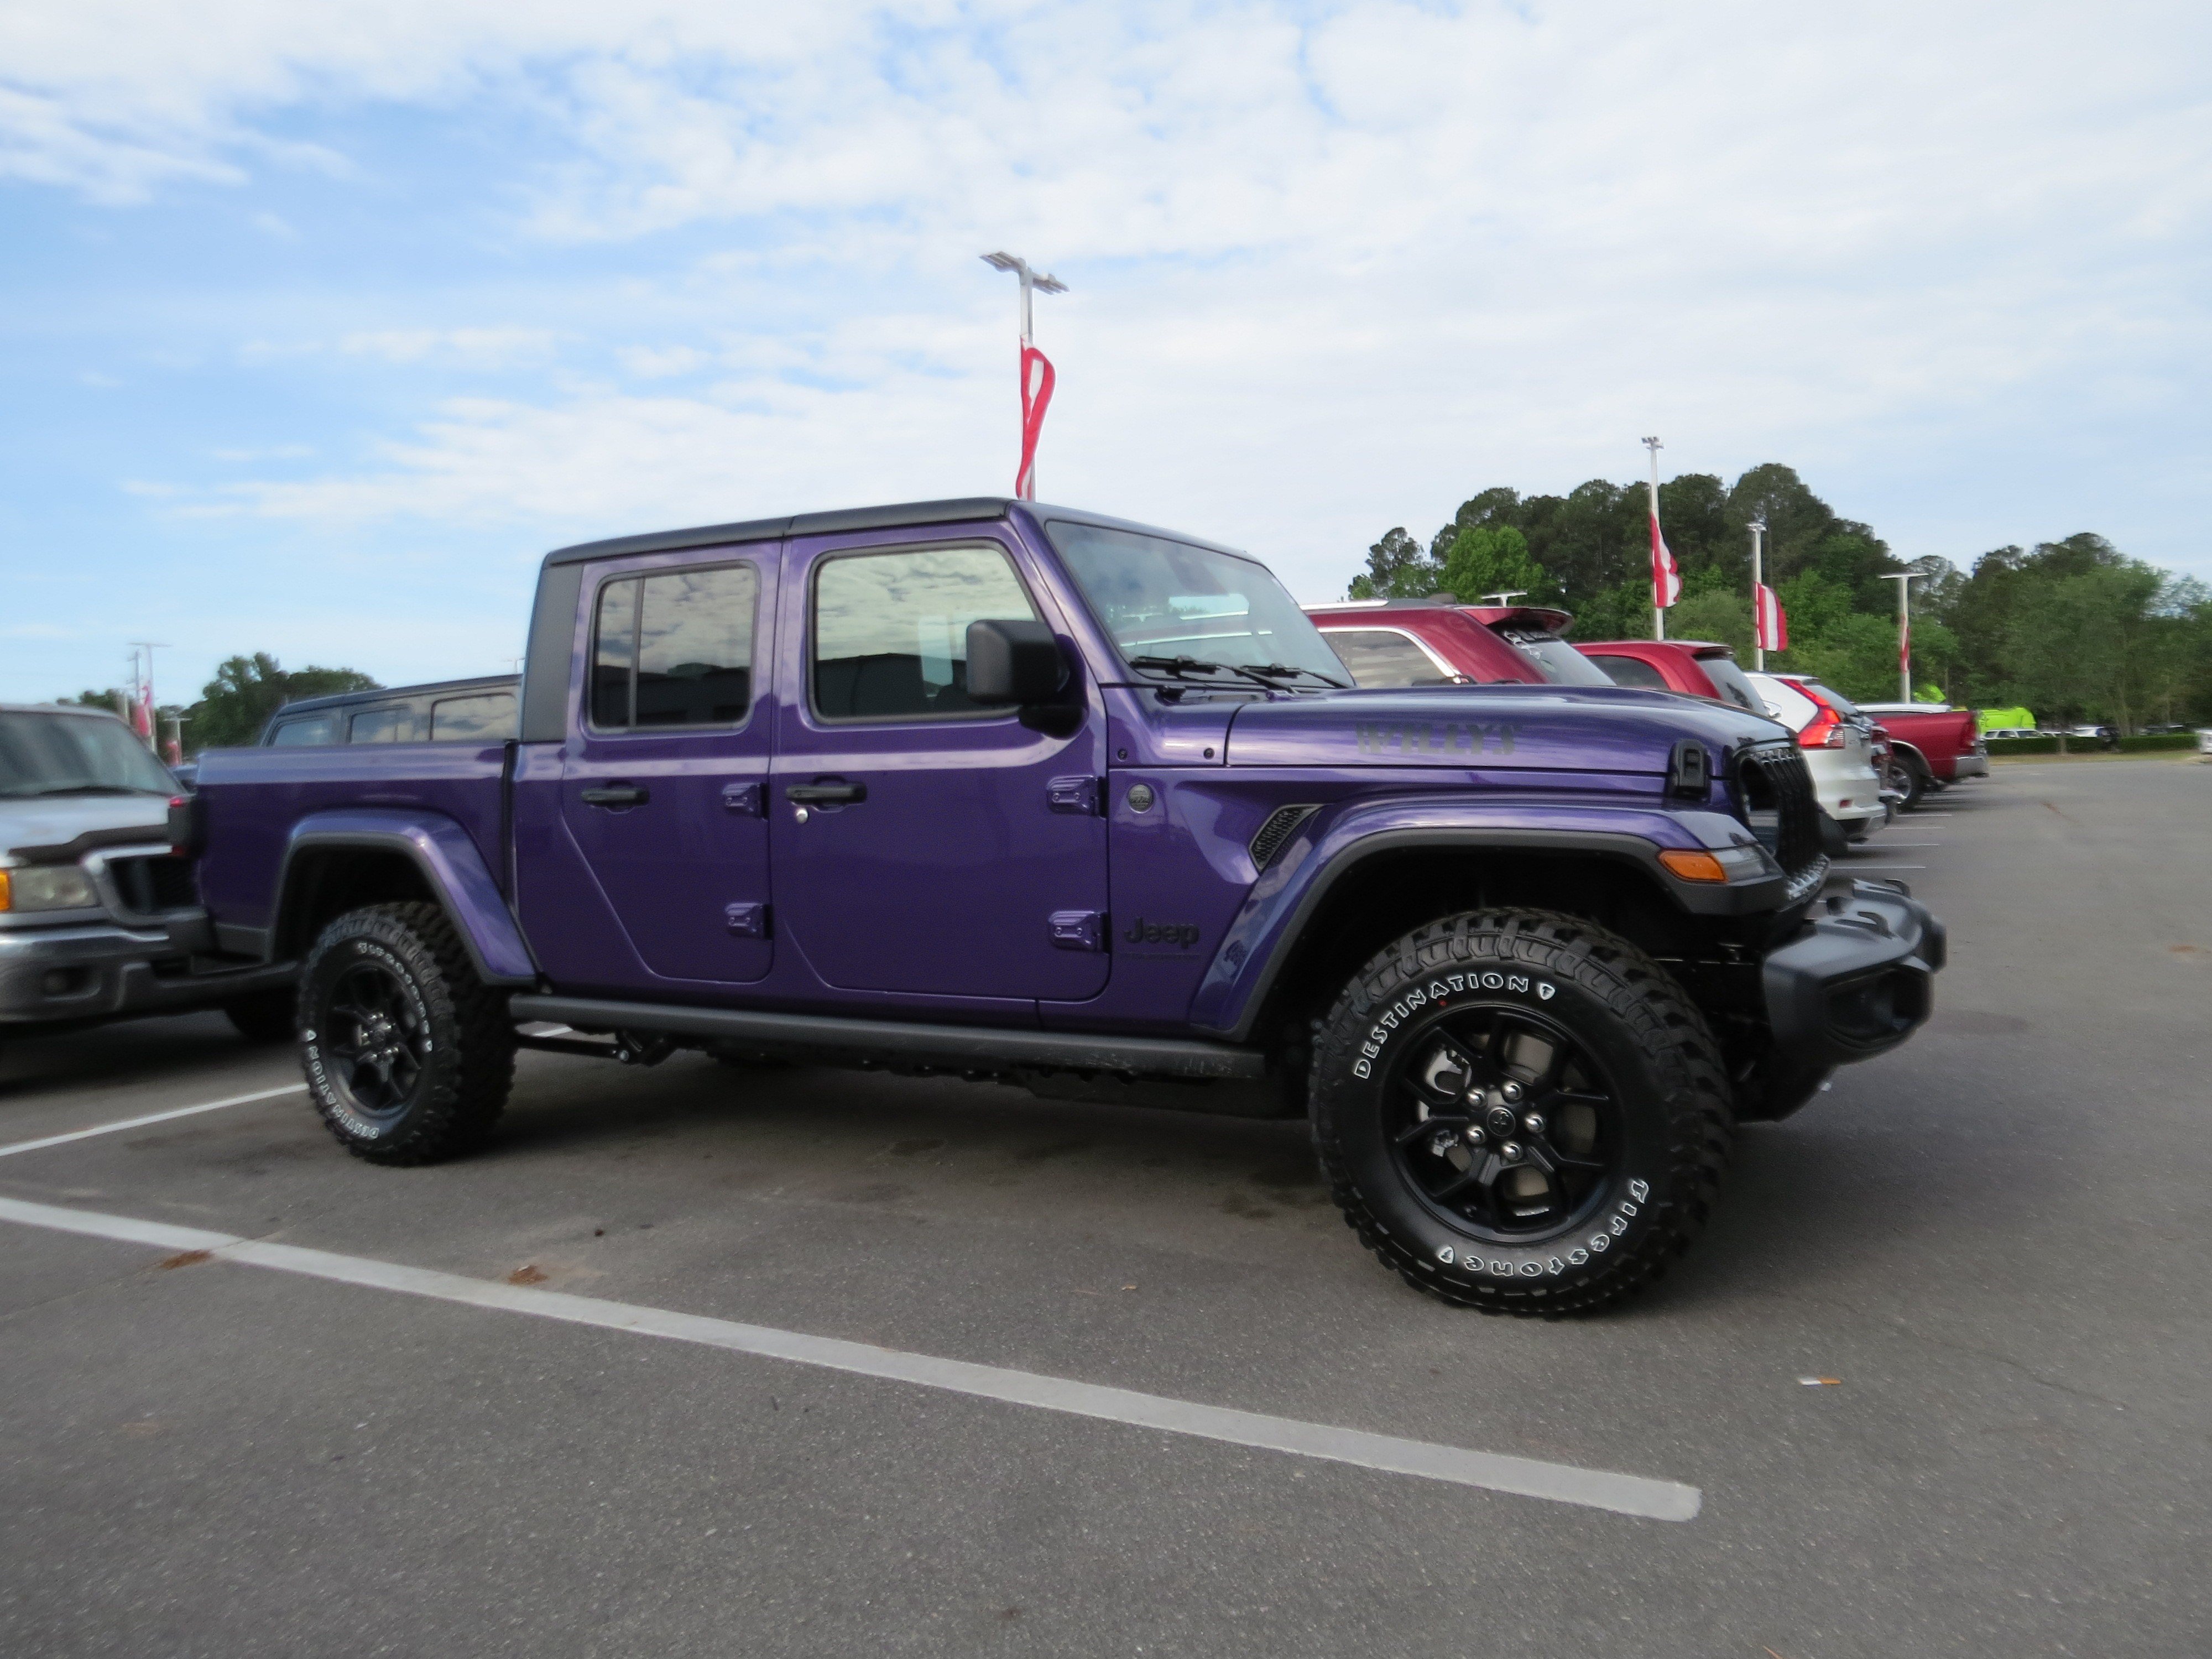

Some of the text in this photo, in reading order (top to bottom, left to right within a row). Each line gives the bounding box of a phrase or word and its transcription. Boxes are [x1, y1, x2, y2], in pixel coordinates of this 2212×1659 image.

[1124, 917, 1200, 949] Jeep
[1354, 973, 1528, 1079] DESTINATION
[1464, 1178, 1649, 1277] Firestone
